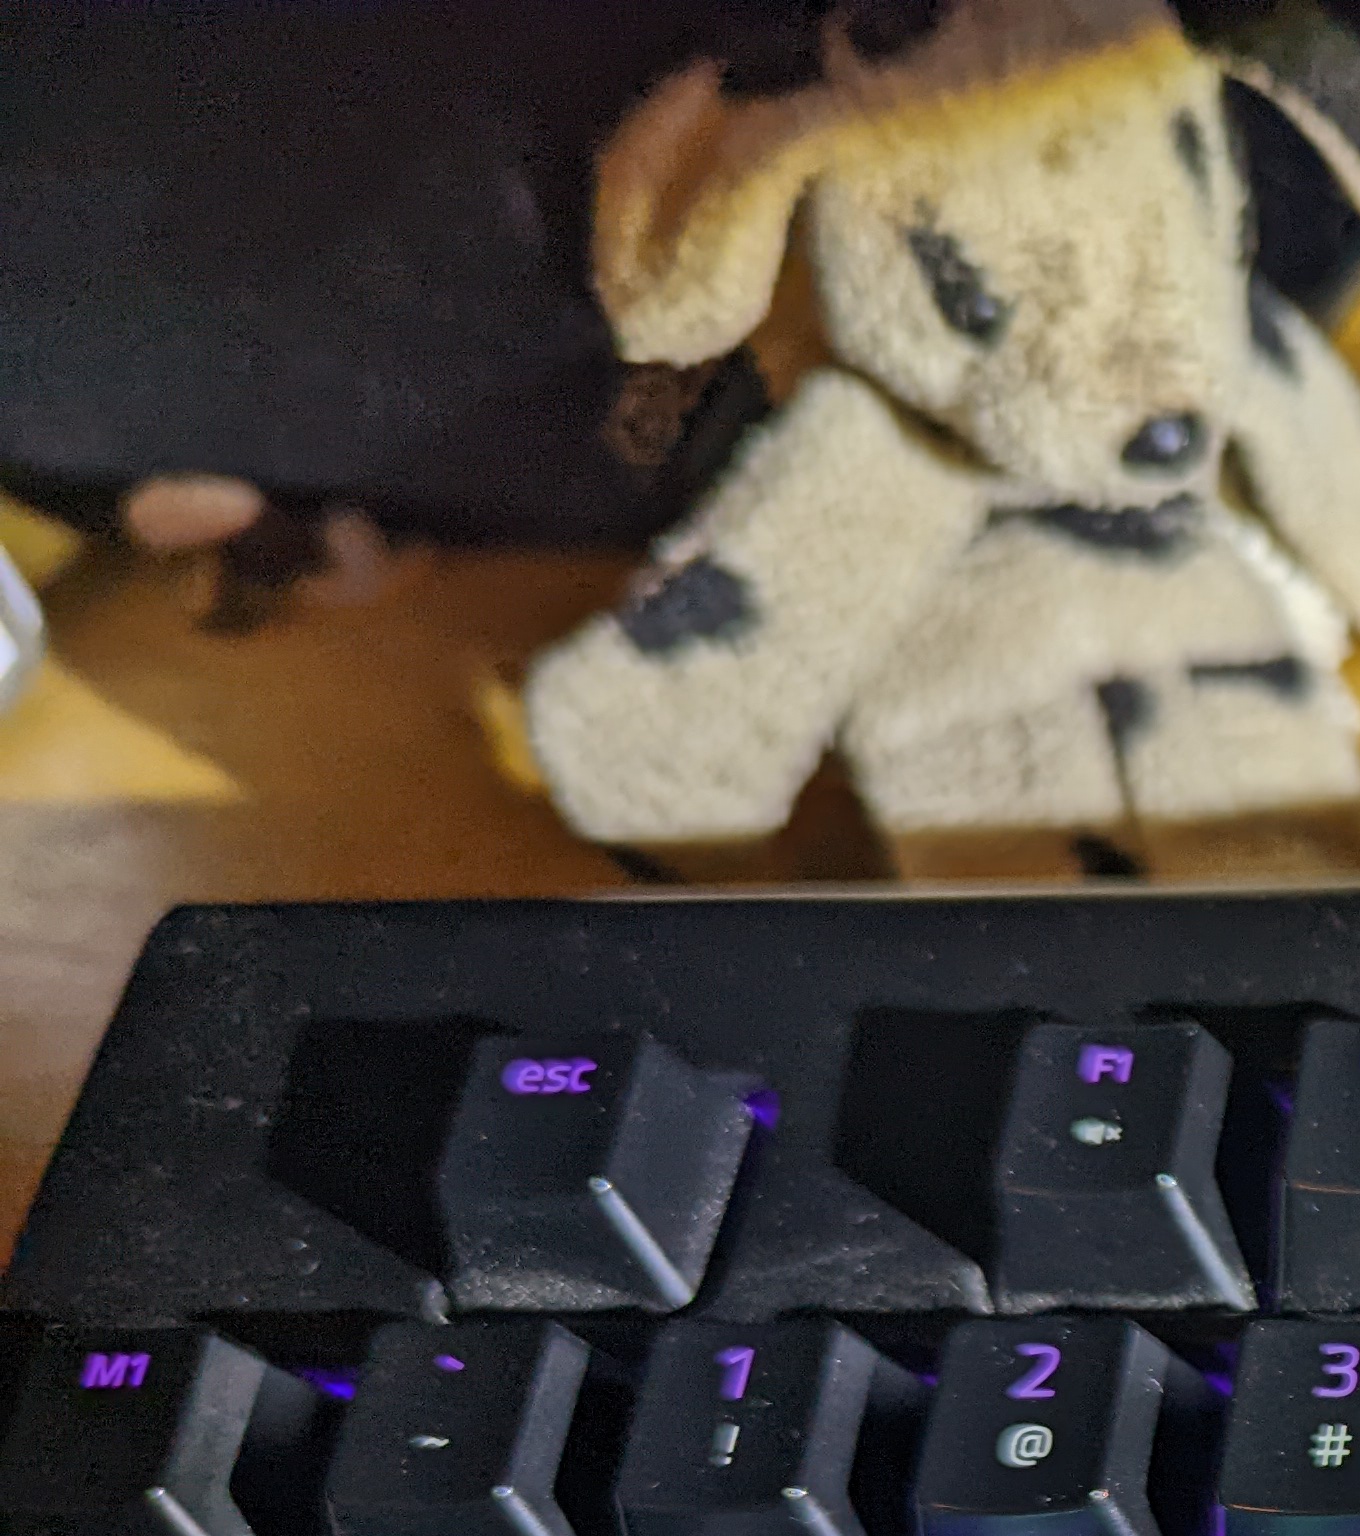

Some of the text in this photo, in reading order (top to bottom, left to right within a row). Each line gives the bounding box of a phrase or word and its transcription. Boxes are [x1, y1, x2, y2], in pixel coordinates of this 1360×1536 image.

[503, 1056, 596, 1094] esc
[1077, 1044, 1133, 1084] F1
[81, 1353, 150, 1388] M1
[717, 1347, 754, 1398] 1
[1006, 1342, 1061, 1399] 2
[1312, 1342, 1360, 1398] 3
[997, 1422, 1053, 1467] @
[1309, 1424, 1353, 1466] #
